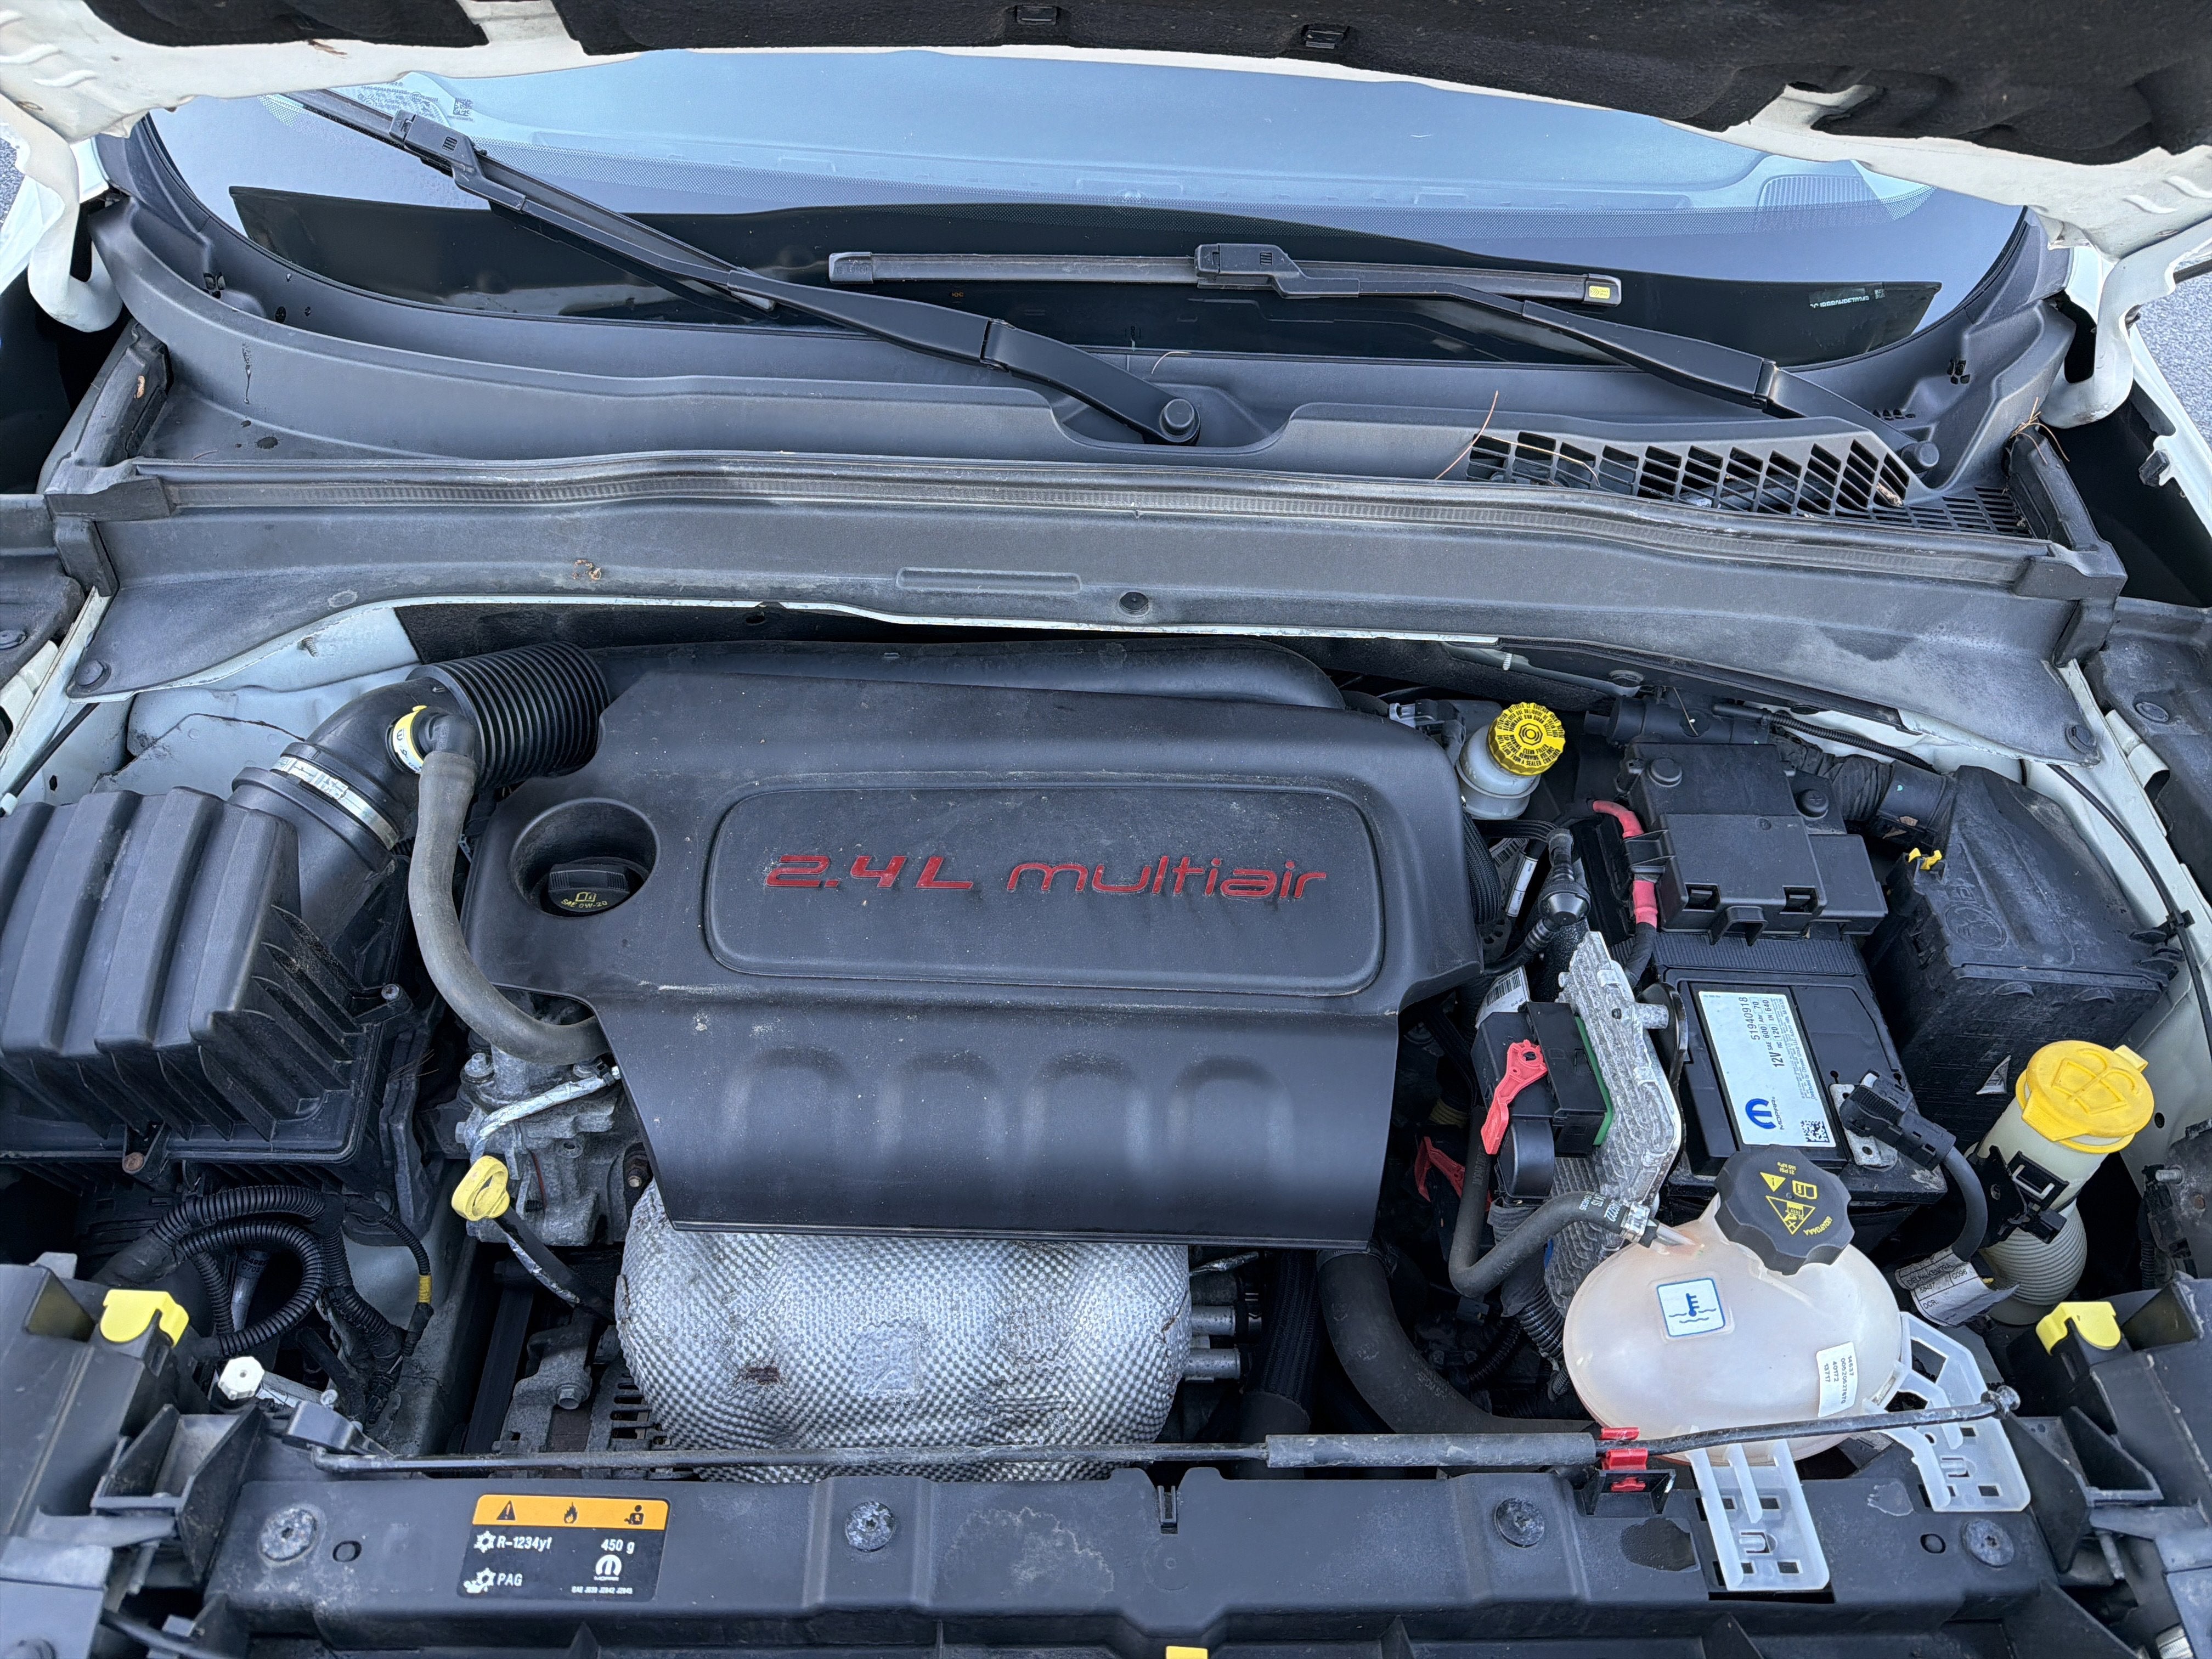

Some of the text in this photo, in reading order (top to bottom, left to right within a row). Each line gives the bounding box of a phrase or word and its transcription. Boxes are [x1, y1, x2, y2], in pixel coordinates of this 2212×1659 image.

[1506, 741, 1519, 754] BEFORE
[1536, 743, 1549, 754] FILLER
[1006, 855, 1327, 900] multiair
[561, 899, 577, 907] SAE
[1753, 1001, 1759, 1010] 70
[1739, 997, 1761, 1041] 51940918
[1762, 1026, 1771, 1039] 600
[1770, 1052, 1785, 1068] 12V
[497, 1536, 635, 1554] R-1234yf 450 g
[496, 1573, 523, 1587] PAG
